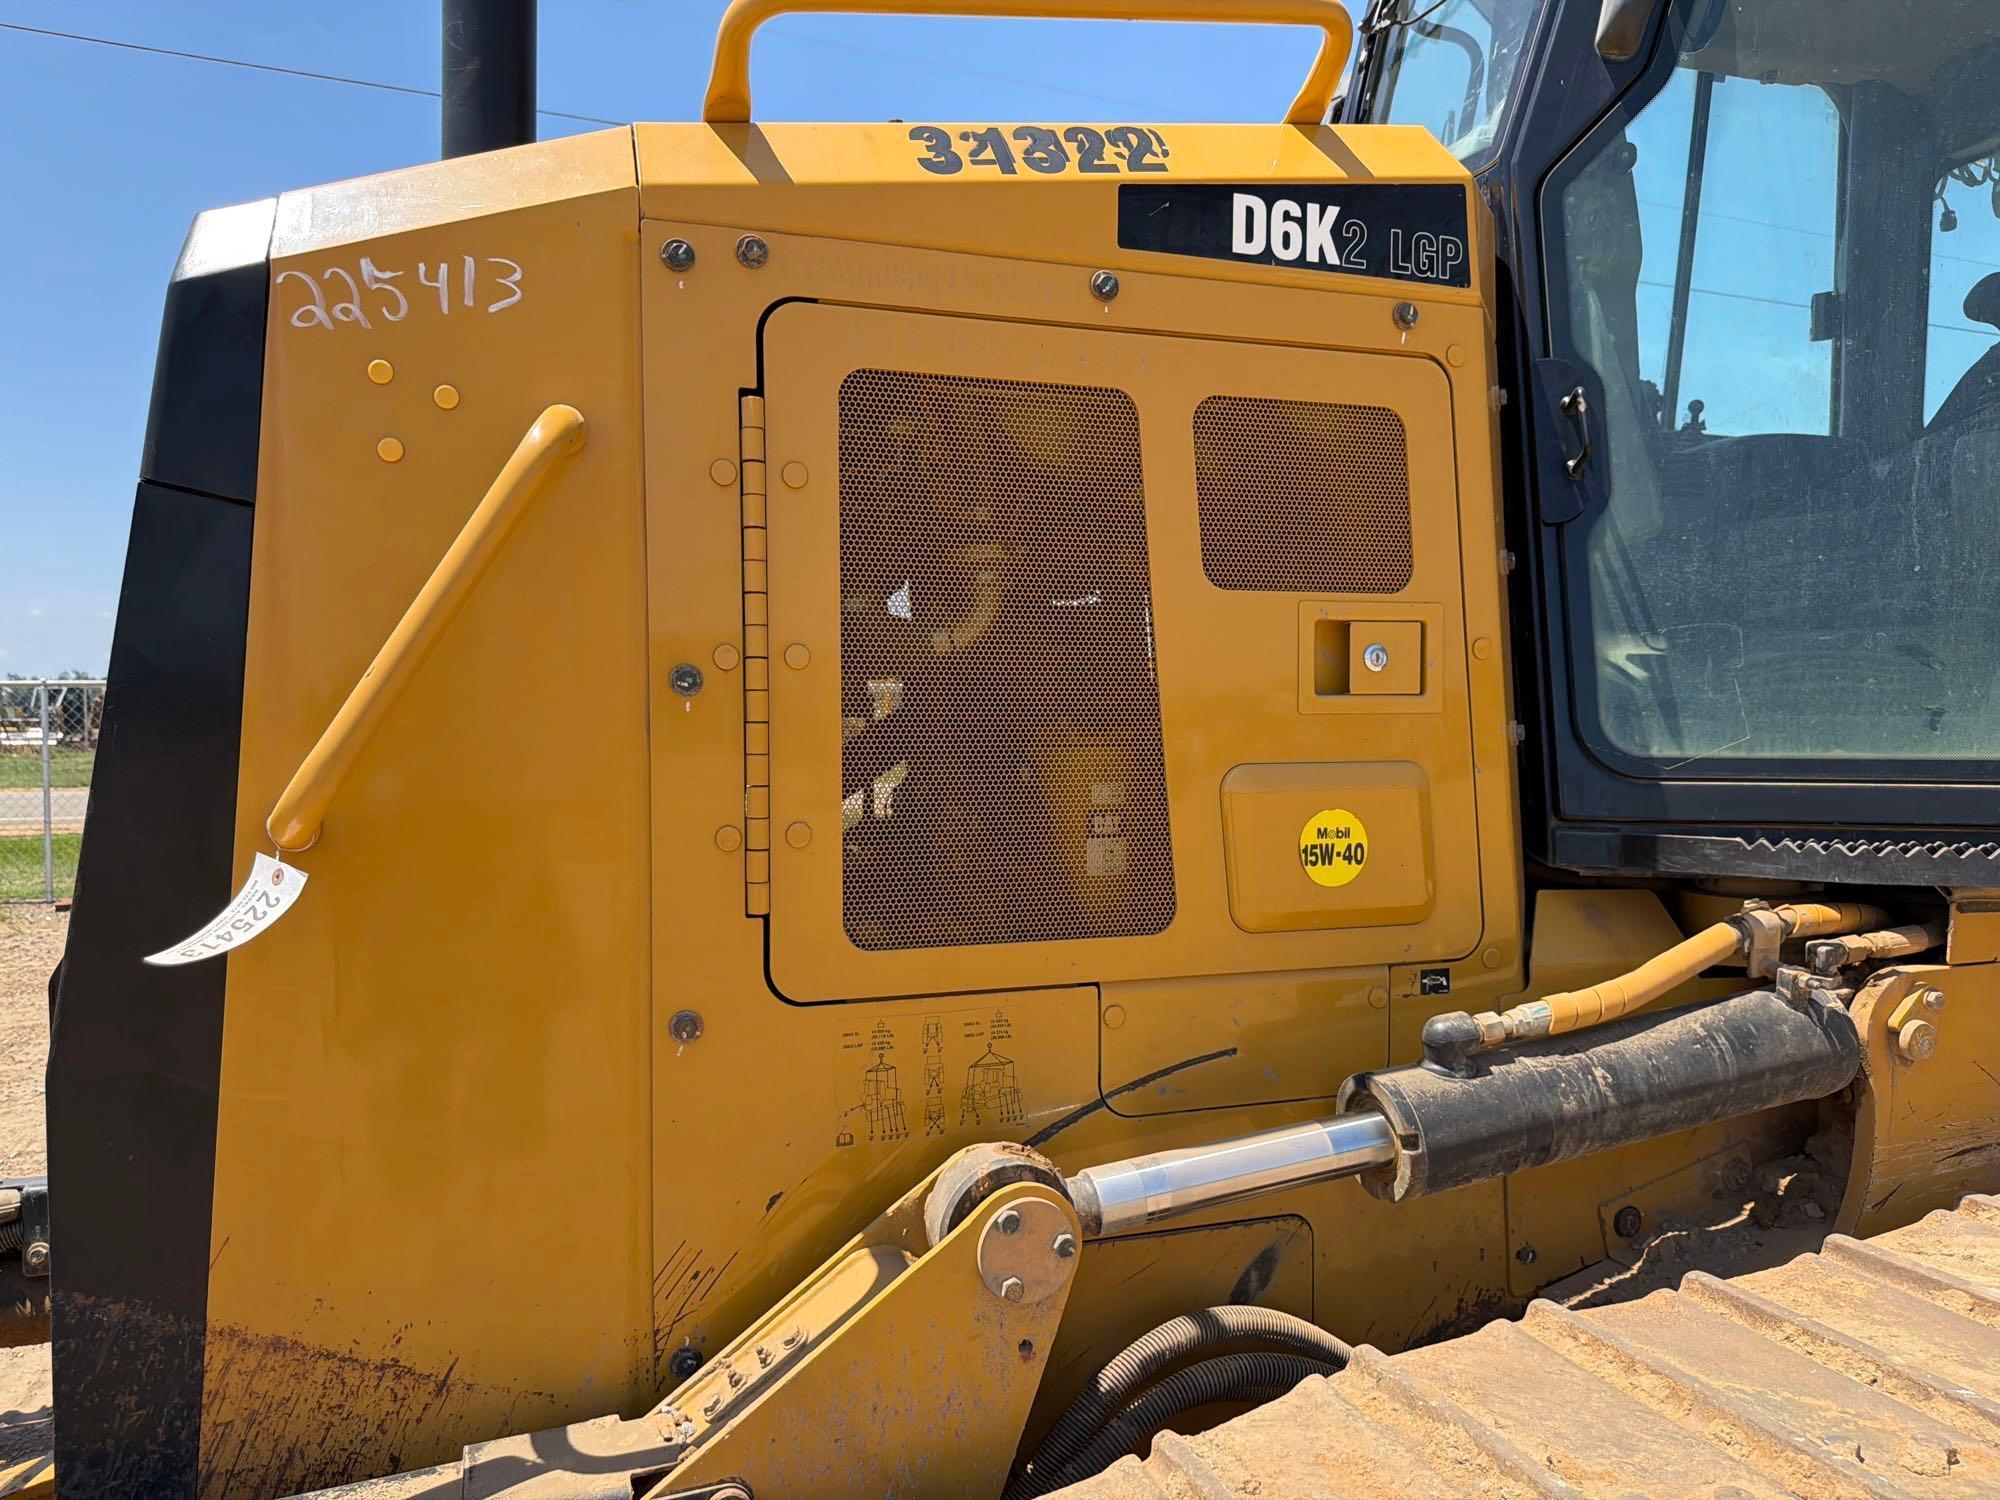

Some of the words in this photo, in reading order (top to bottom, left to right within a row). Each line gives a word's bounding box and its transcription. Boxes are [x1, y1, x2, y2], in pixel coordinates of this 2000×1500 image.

[1390, 229, 1463, 280] LGP
[275, 255, 523, 331] 225413
[1302, 842, 1365, 867] 15W-40
[1316, 827, 1351, 840] Mobil
[180, 890, 281, 958] 225413
